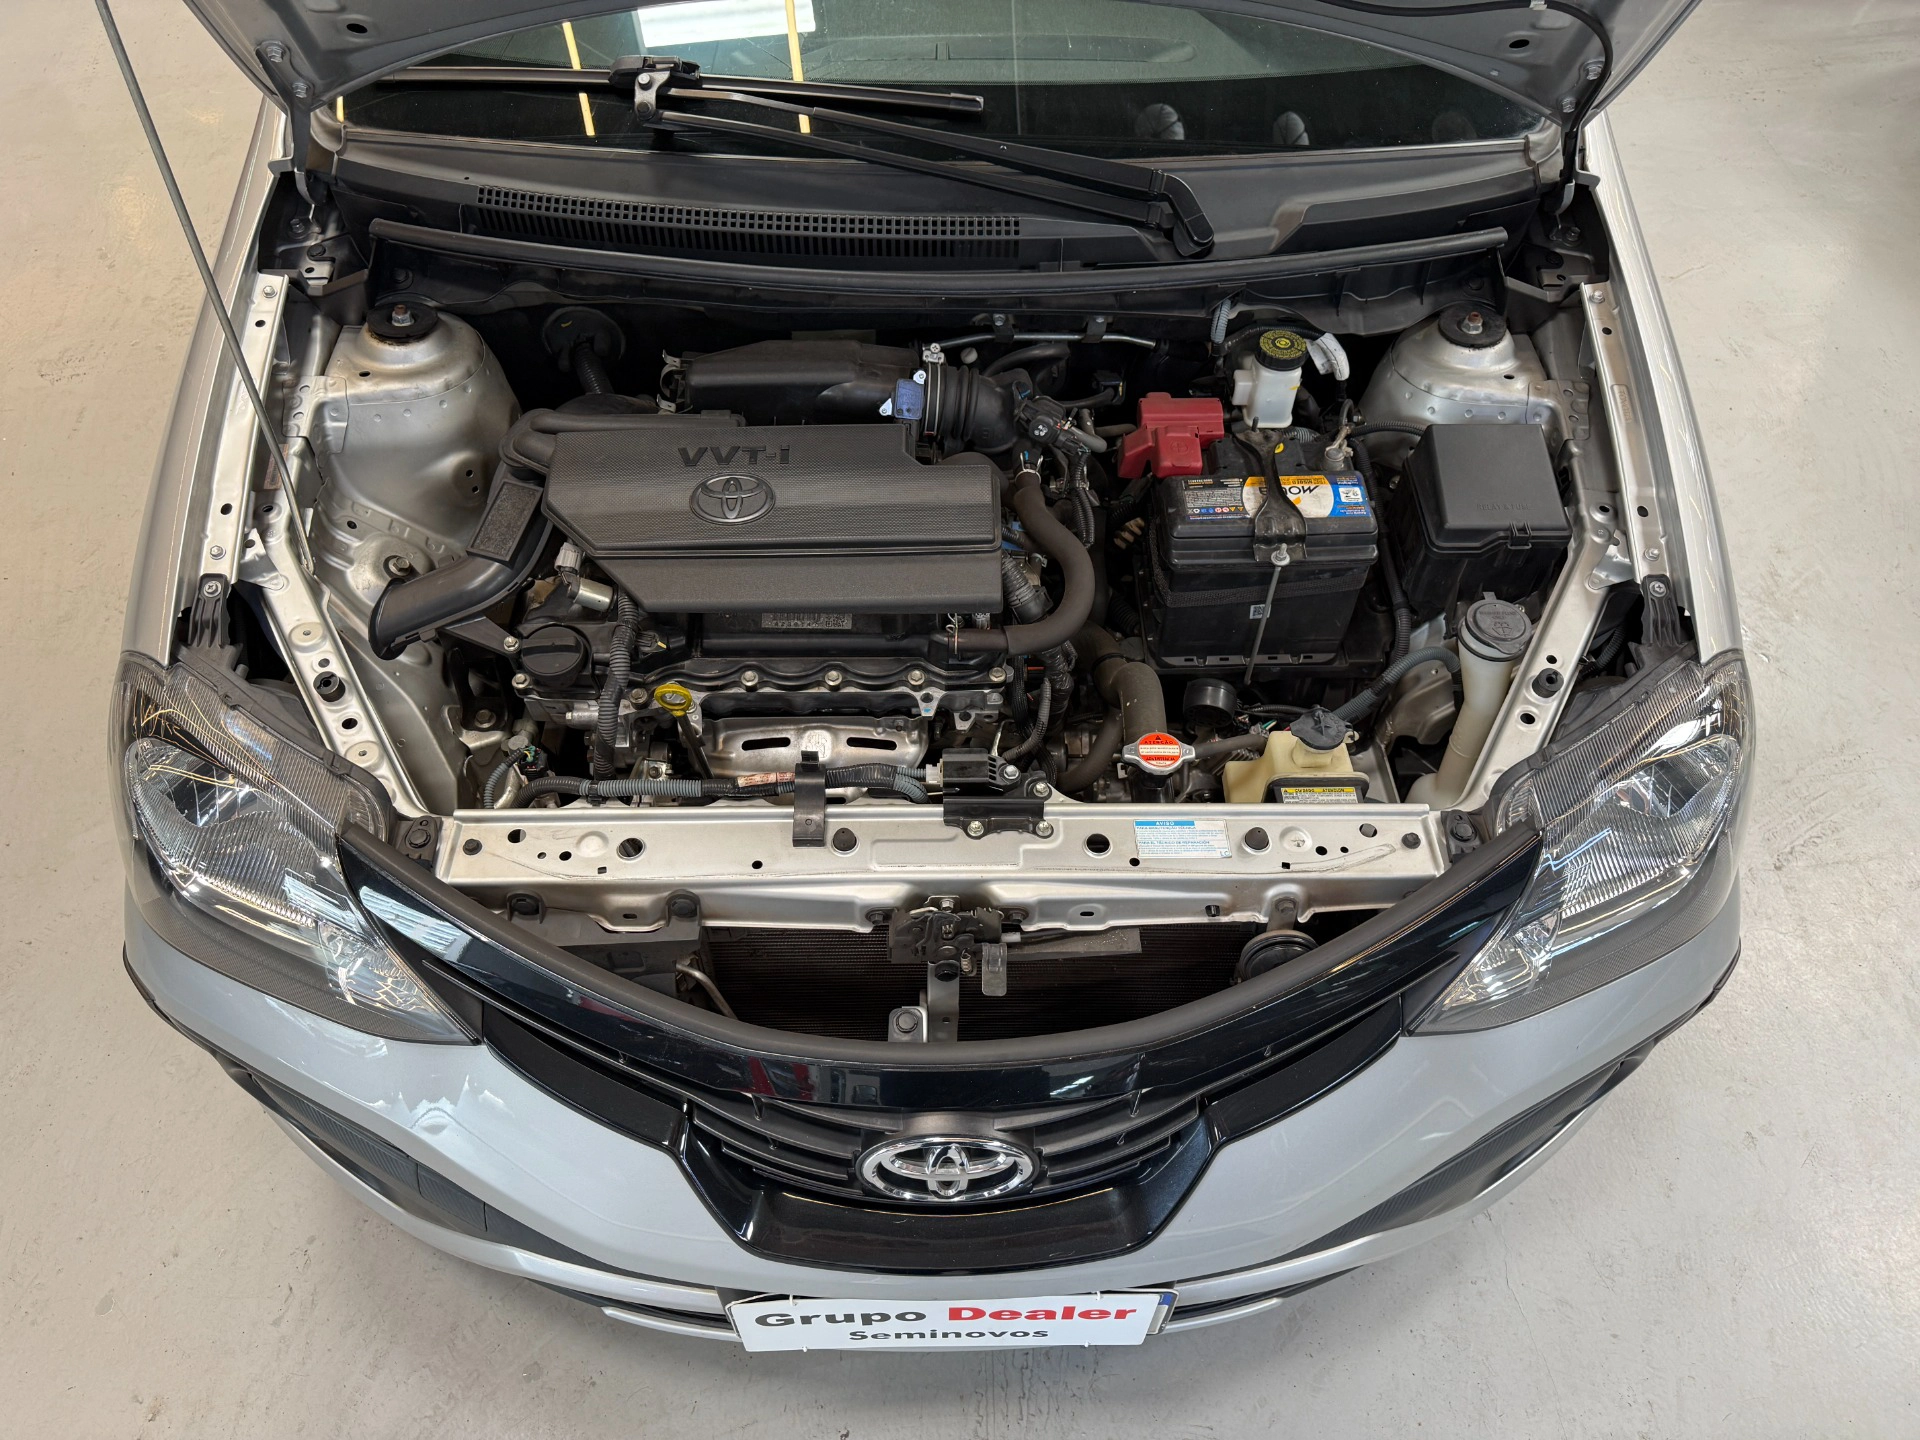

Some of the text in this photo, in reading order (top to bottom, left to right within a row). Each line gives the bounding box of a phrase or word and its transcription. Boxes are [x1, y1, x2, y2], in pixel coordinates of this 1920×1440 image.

[755, 1306, 1137, 1327] Grupo Dealer
[849, 1329, 1049, 1341] Seminovos
